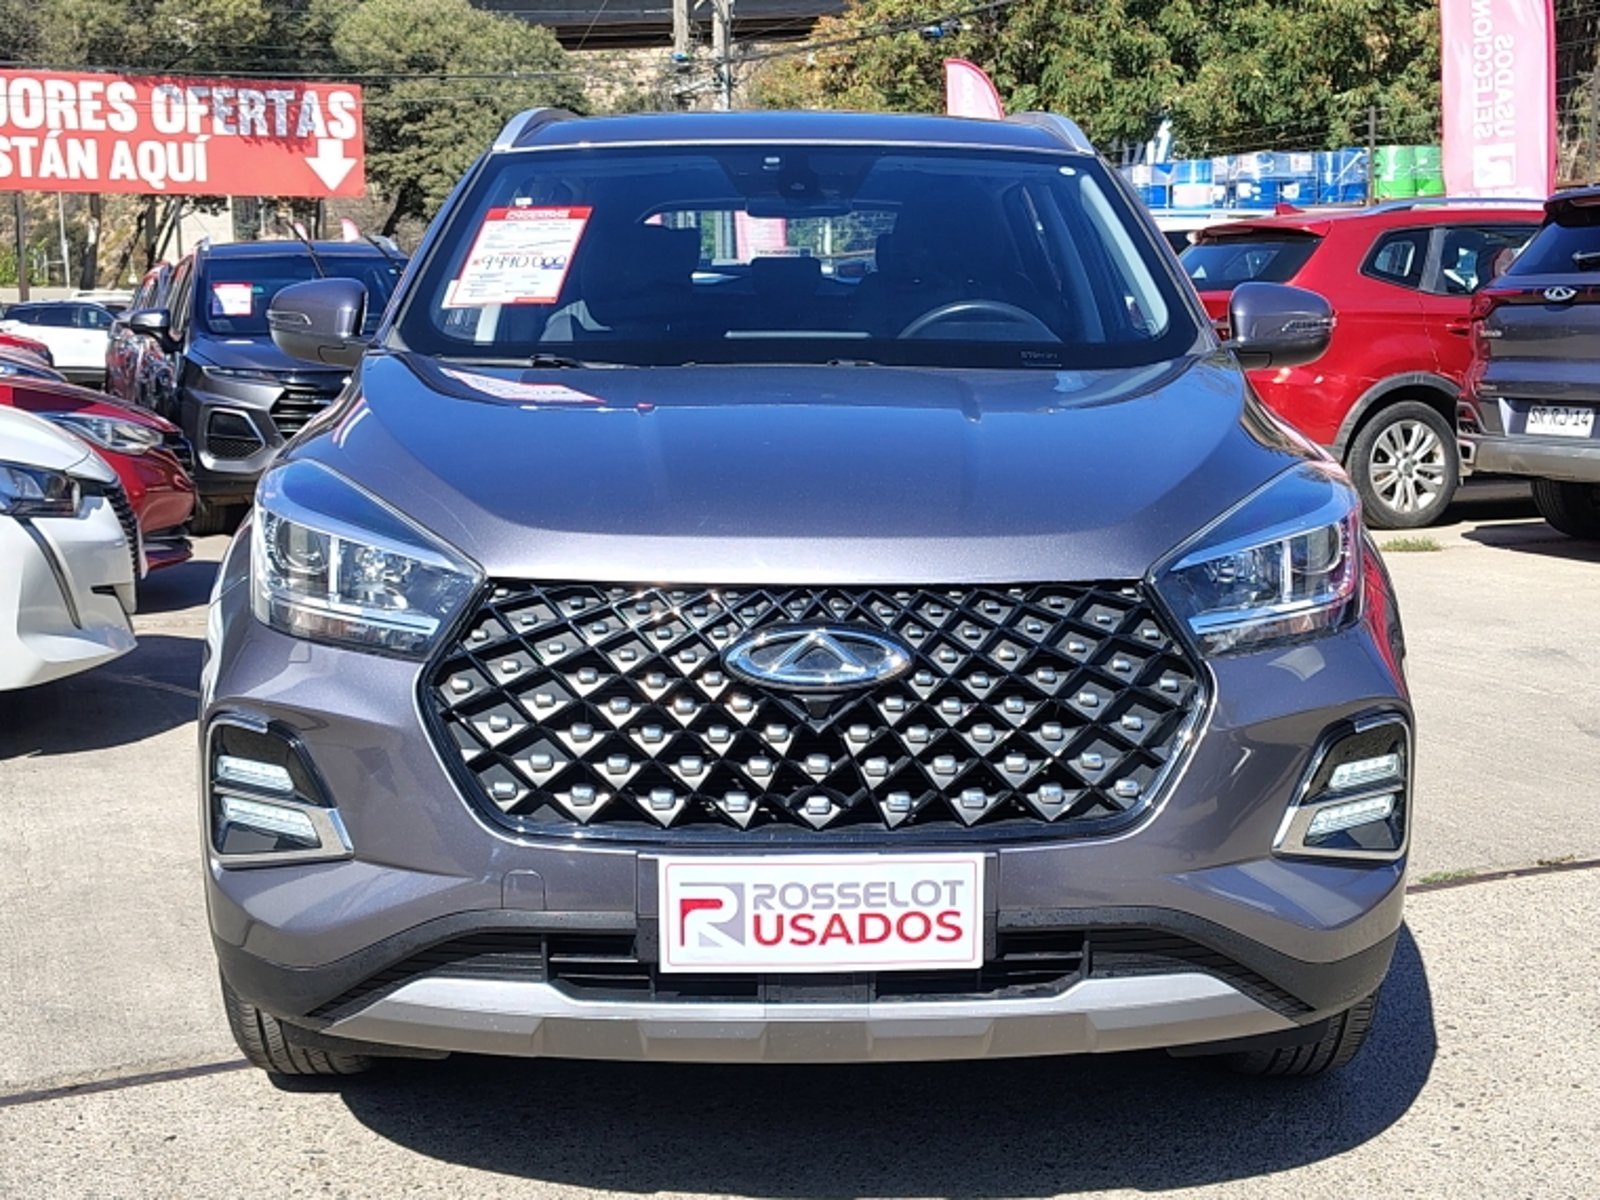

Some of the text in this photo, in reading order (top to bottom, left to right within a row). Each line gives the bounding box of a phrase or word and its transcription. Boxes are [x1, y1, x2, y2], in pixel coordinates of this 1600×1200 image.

[152, 83, 357, 140] OFERTAS
[109, 134, 210, 189] AQUÍ
[753, 880, 964, 910] ROSSELOT
[753, 911, 963, 946] USADOS
